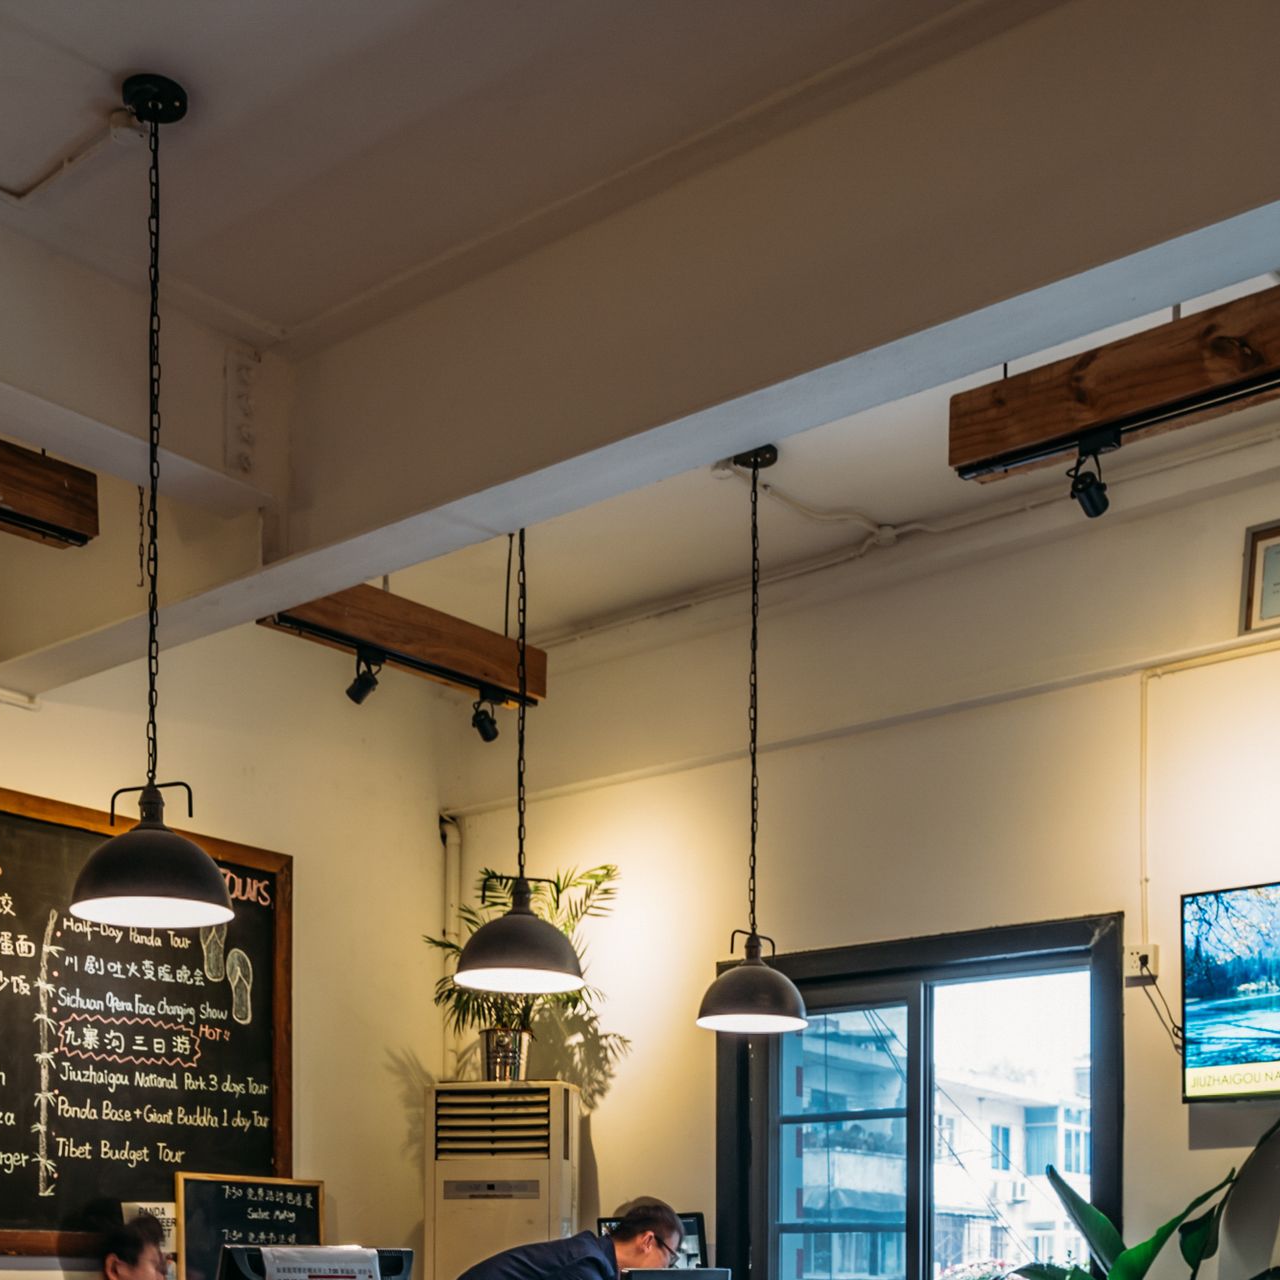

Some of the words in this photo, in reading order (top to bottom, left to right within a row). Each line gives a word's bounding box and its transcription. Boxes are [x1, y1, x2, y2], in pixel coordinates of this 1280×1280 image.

[168, 930, 192, 949] Tour
[58, 987, 104, 1012] Sichuan
[64, 1024, 192, 1055] 九寨沟三日游
[59, 1061, 130, 1094] Jiuzhaigou
[134, 1071, 178, 1091] National
[184, 1072, 207, 1091] Park
[209, 1075, 218, 1091] 3
[1191, 1072, 1262, 1089] JIUZHAIGOU
[58, 1096, 98, 1121] Panda
[55, 1137, 92, 1159] Tibet
[100, 1140, 150, 1168] Budget
[156, 1142, 186, 1164] Tour
